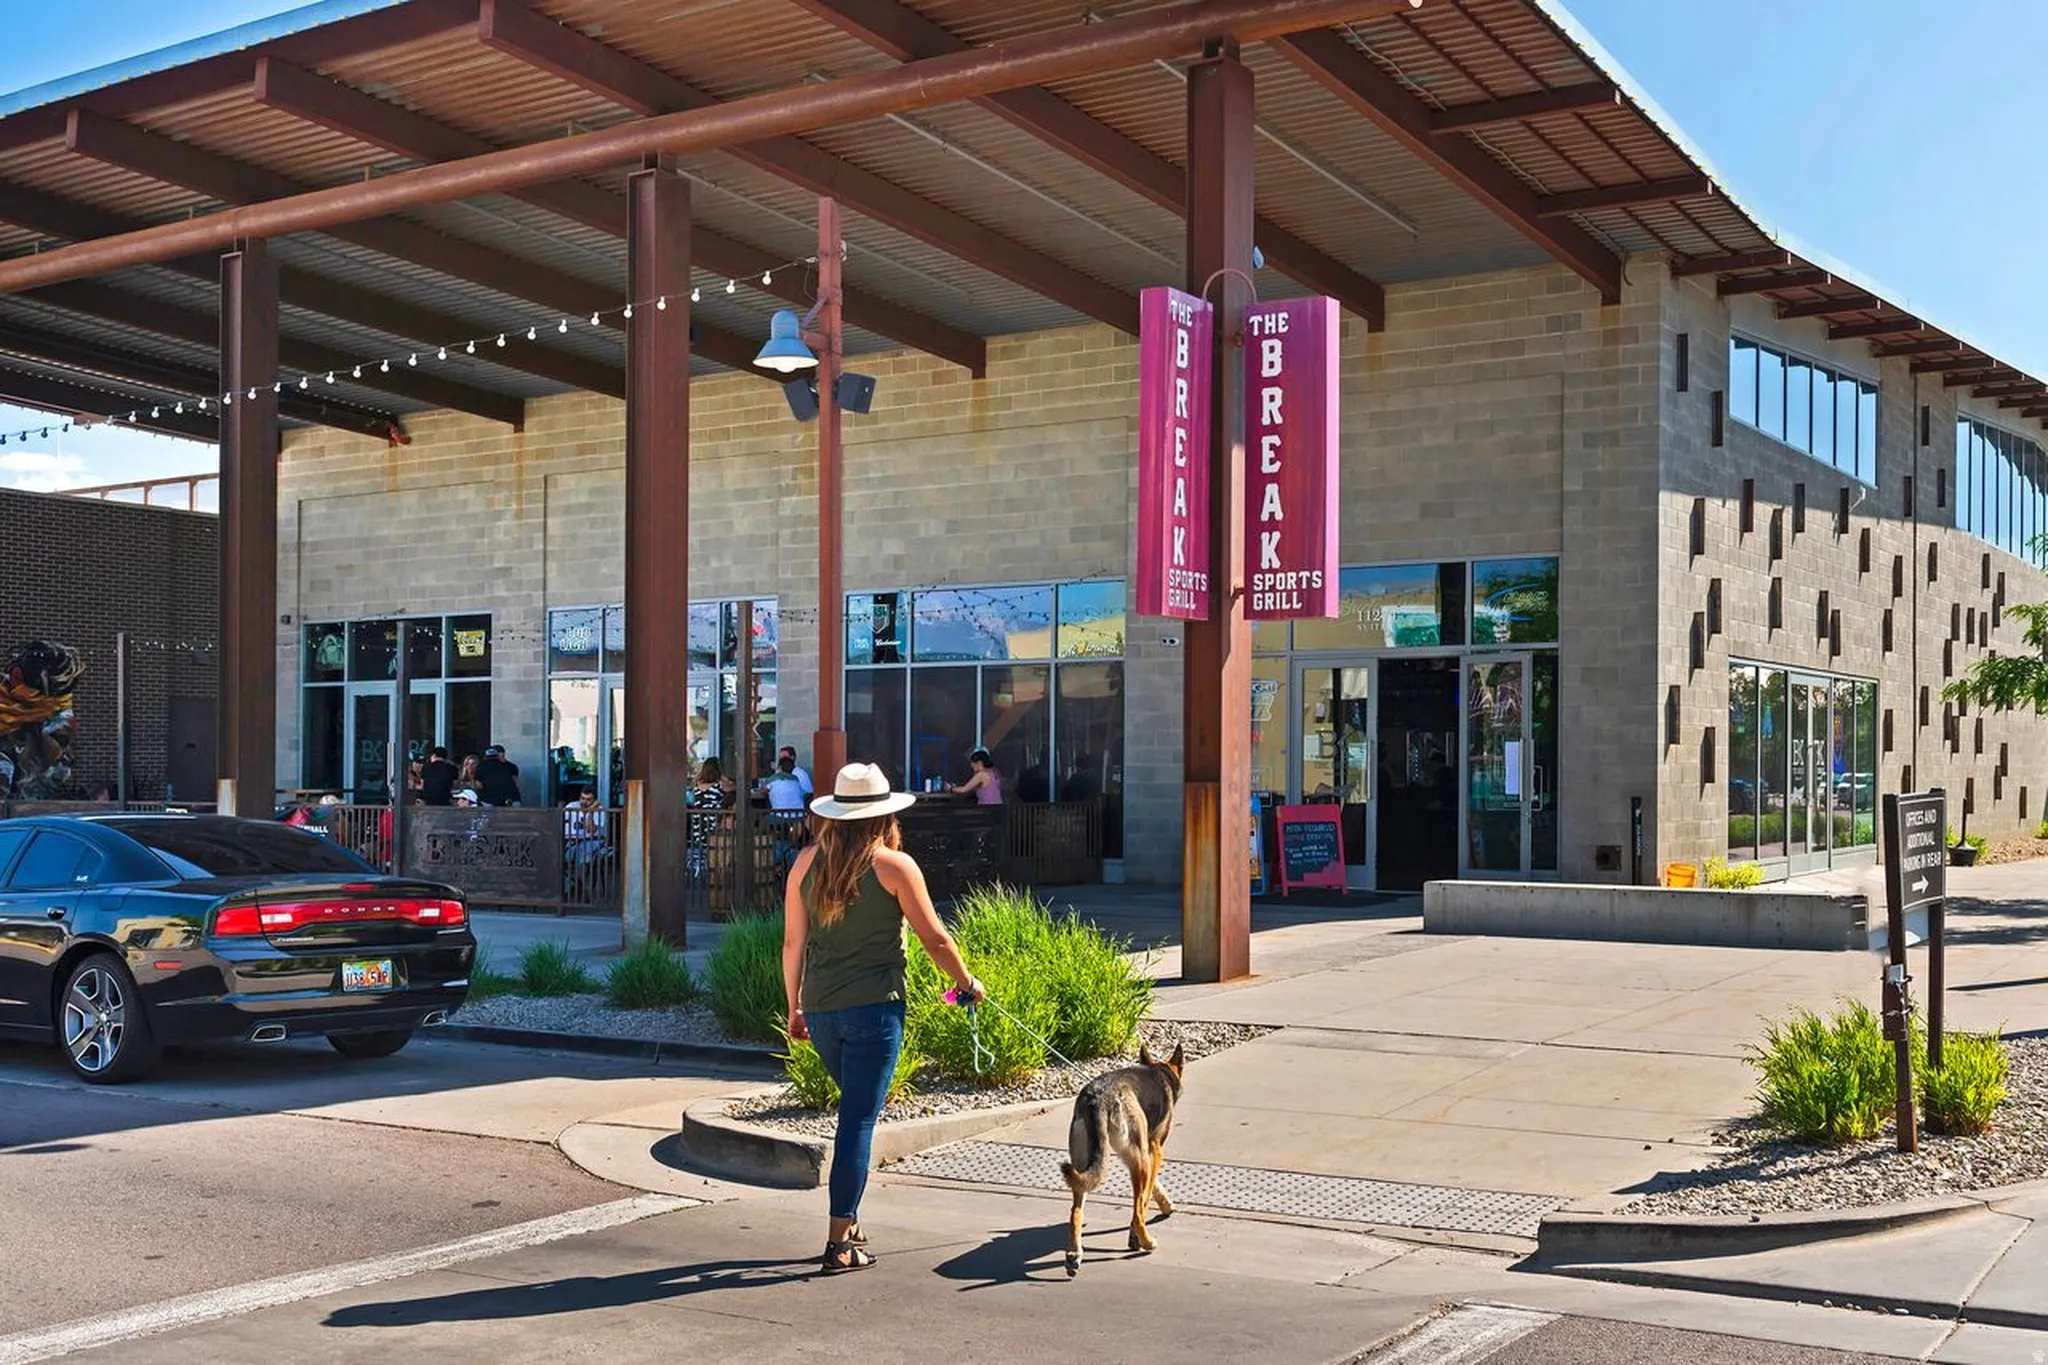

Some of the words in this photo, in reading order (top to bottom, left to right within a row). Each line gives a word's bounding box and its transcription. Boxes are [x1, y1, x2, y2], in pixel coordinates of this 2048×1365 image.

[1170, 299, 1193, 327] THE
[1250, 312, 1289, 336] THE
[1172, 328, 1189, 566] BREAK
[1260, 338, 1284, 570] BREAK
[1168, 568, 1208, 592] SPORTS
[1253, 571, 1323, 592] SPORTS
[1168, 588, 1196, 610] GRILL
[1253, 591, 1302, 611] GRILL
[1925, 809, 1937, 824] AND
